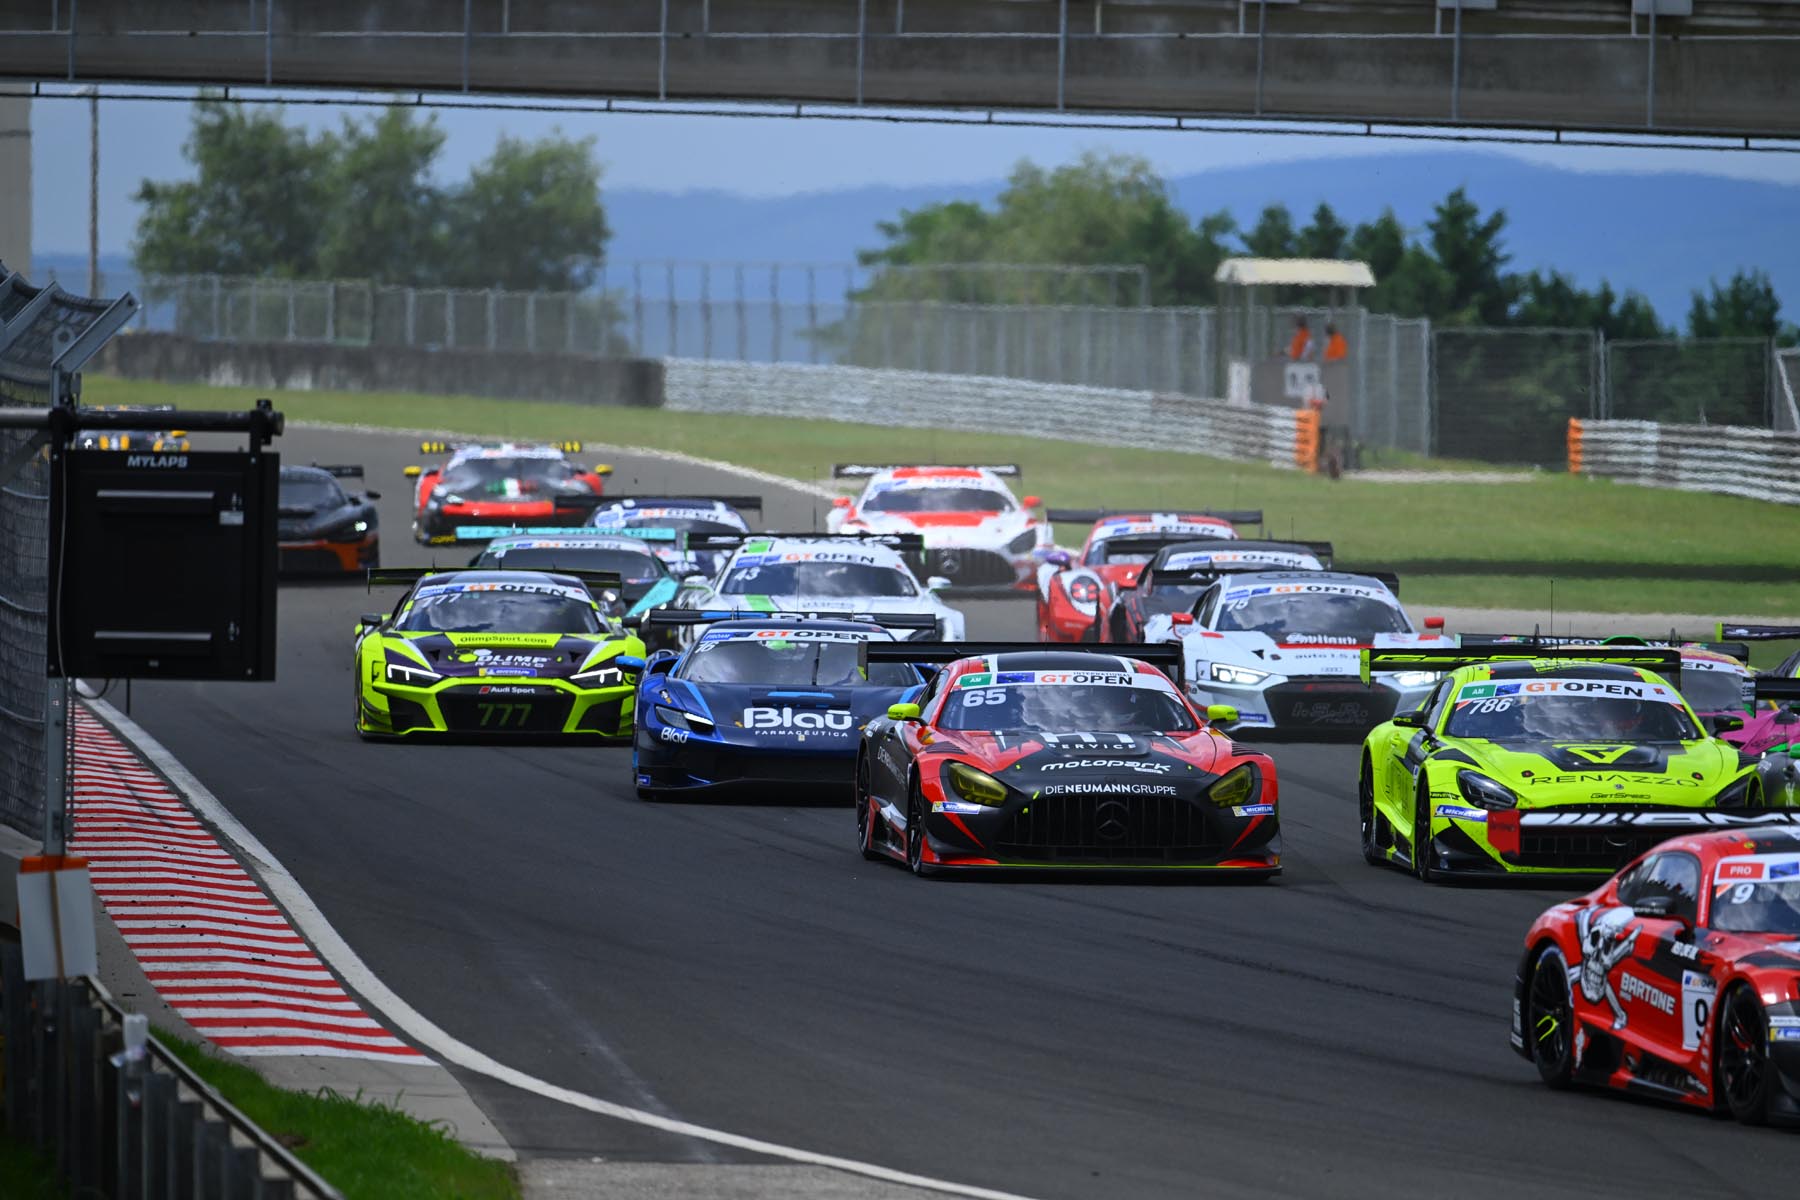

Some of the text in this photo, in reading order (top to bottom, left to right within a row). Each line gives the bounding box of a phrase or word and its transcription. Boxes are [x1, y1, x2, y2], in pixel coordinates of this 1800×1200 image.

[127, 455, 188, 468] MYLAPS
[421, 593, 462, 609] 777
[511, 686, 535, 694] Sport
[962, 688, 1006, 708] 65
[478, 703, 532, 726] 777
[1468, 698, 1514, 715] 786
[1040, 759, 1172, 772] motopark
[1729, 865, 1752, 875] PRO
[1731, 883, 1755, 904] 9
[1620, 971, 1676, 1016] BARTONE
[1695, 998, 1709, 1041] 9
